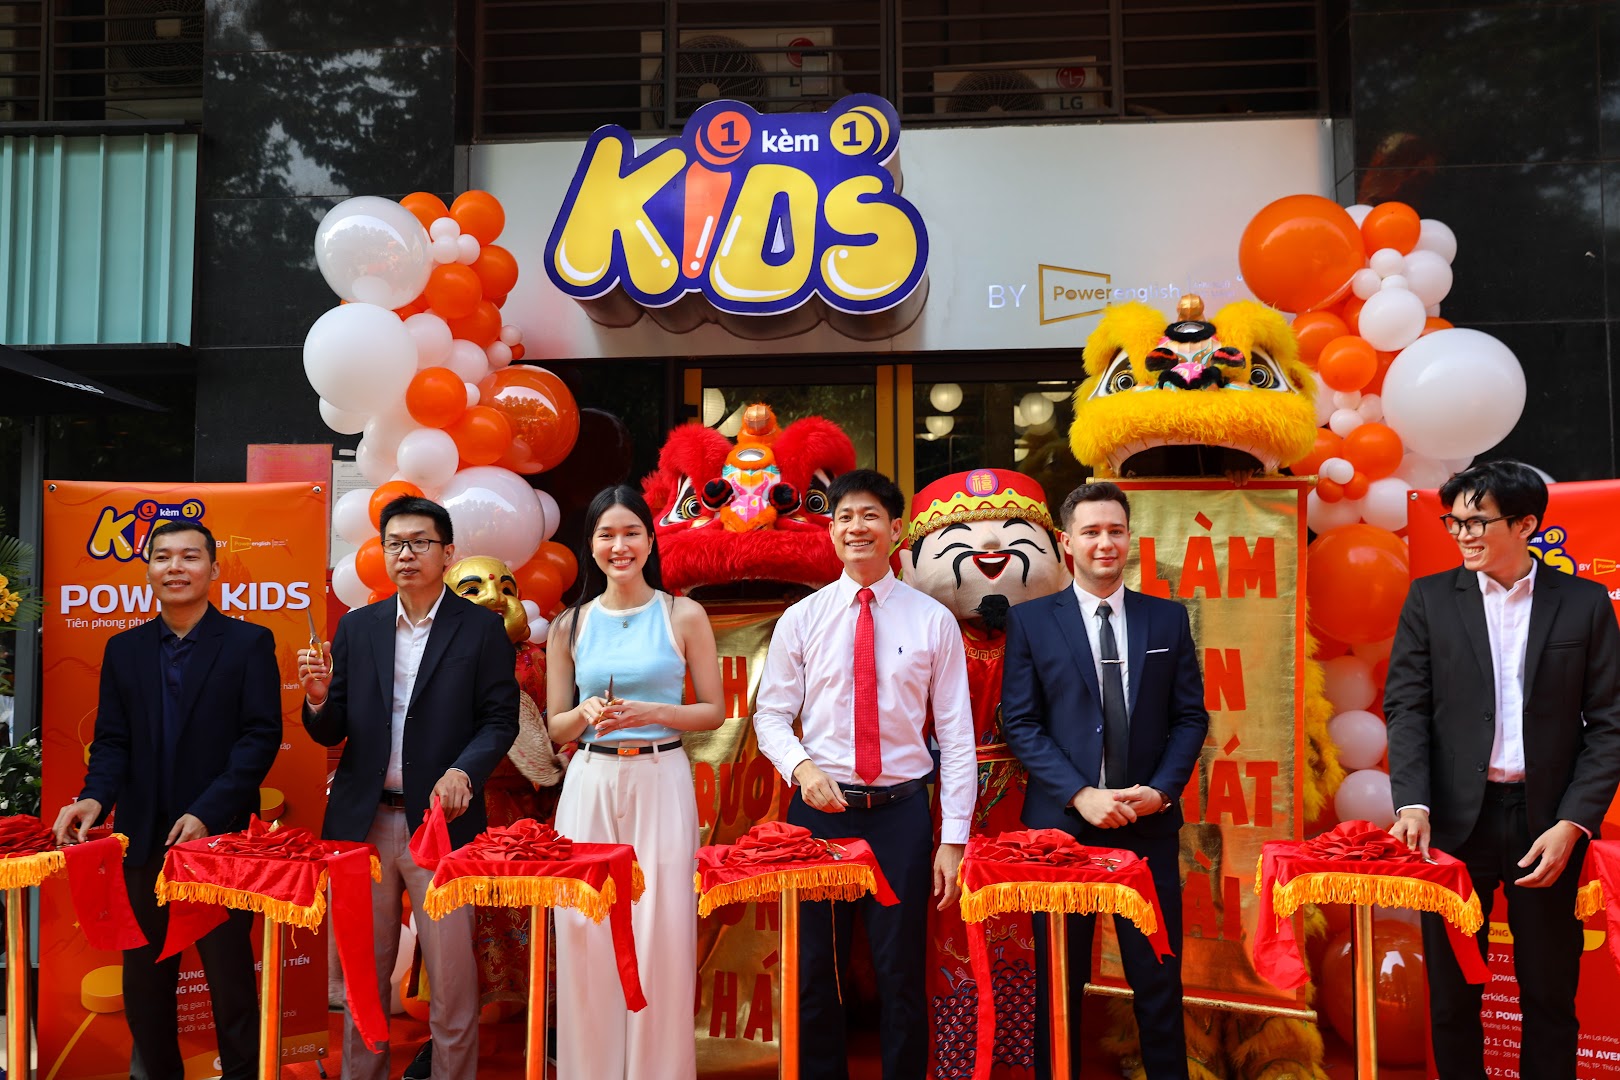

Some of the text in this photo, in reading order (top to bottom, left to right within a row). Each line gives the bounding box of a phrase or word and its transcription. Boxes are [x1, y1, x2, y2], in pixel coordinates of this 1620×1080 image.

[1060, 96, 1083, 110] LG
[720, 120, 862, 154] 1 kèm 1
[988, 284, 1027, 309] BY
[159, 507, 180, 517] kèm
[1139, 511, 1277, 598] LÀM
[1578, 563, 1591, 571] BY
[60, 581, 311, 615] POW KIDS
[65, 617, 89, 628] Tiên
[91, 617, 126, 630] phong
[289, 954, 310, 967] TIẾN
[291, 1044, 316, 1055] 1488
